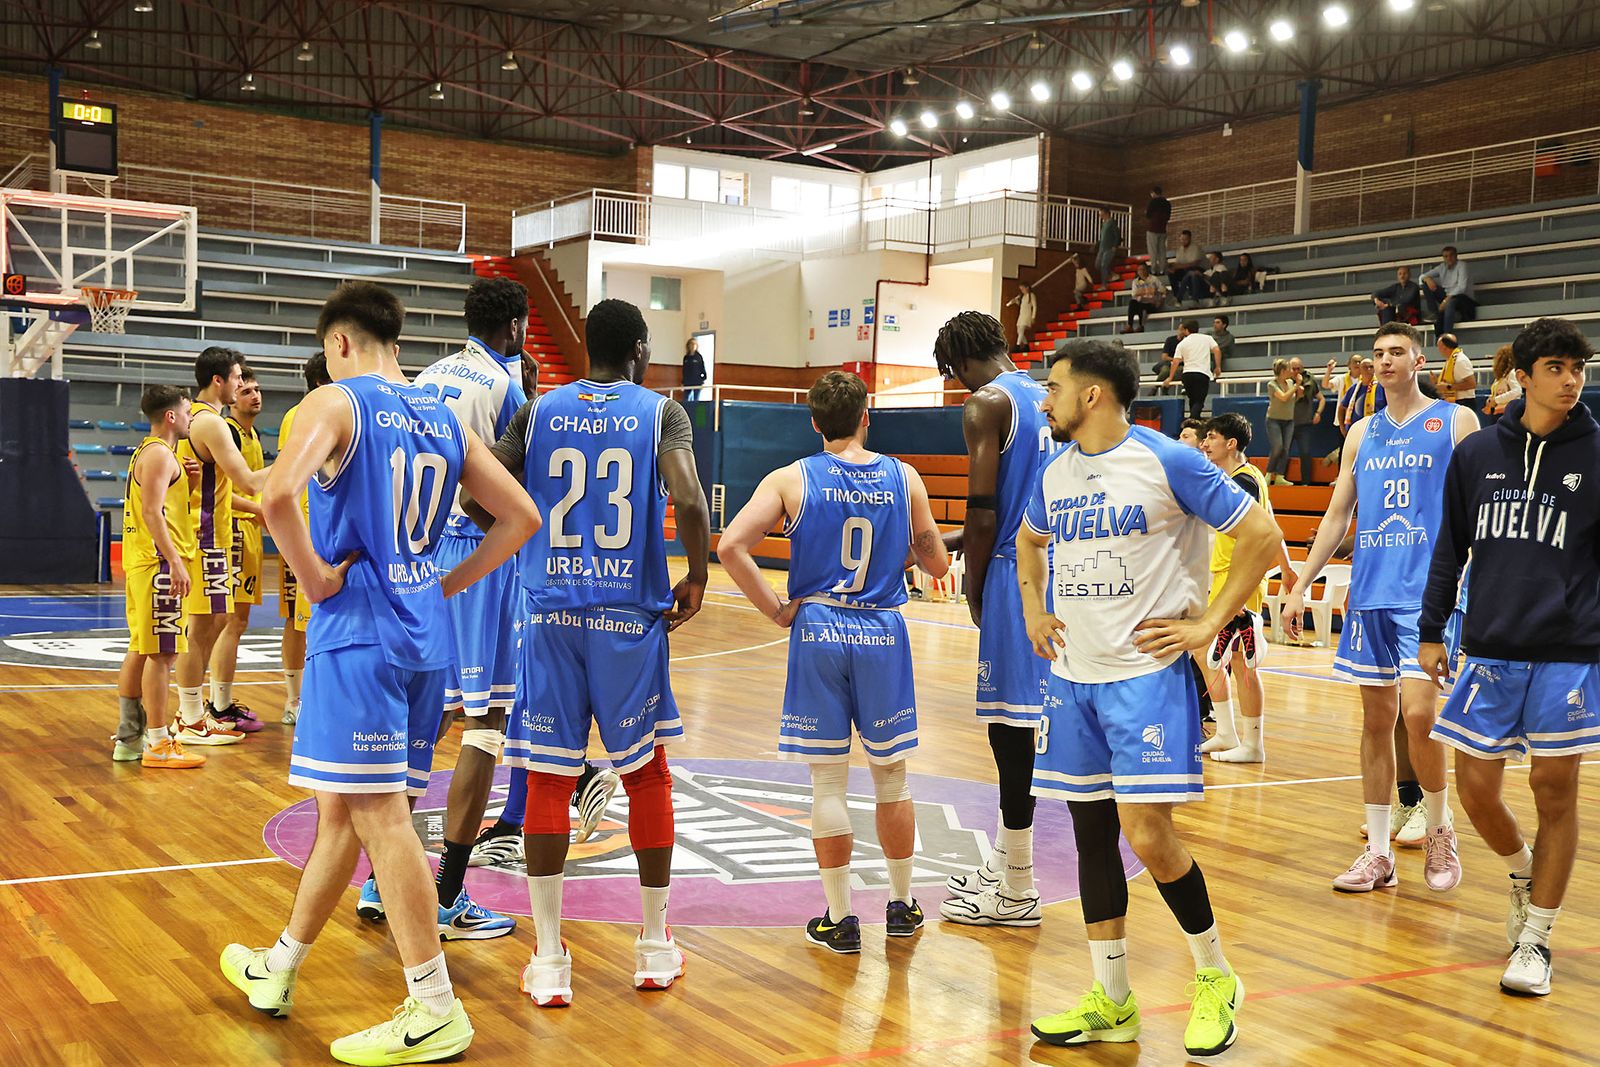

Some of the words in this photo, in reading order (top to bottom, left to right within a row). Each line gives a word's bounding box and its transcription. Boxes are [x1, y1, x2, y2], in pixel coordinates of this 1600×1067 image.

[74, 103, 102, 123] 0:0
[549, 415, 608, 435] CHABI
[612, 415, 639, 432] YO
[390, 446, 448, 555] 10
[548, 447, 633, 550] 23
[821, 487, 895, 505] TIMONER
[1049, 494, 1089, 513] CIUDAD
[1090, 491, 1106, 506] DE
[1383, 478, 1410, 509] 28
[1492, 488, 1535, 501] CIUDAD
[1541, 492, 1556, 507] DE
[1049, 504, 1149, 544] HUELVA
[1475, 501, 1568, 550] HUELVA
[1359, 531, 1429, 549] EMERITA
[832, 516, 874, 594] 9
[582, 578, 633, 590] COOPERATIVAS
[151, 572, 183, 636] UEM
[546, 610, 644, 635] Abundancia
[801, 628, 815, 642] La
[818, 628, 895, 646] Abundancia
[1462, 682, 1481, 715] 1
[531, 712, 555, 724] eleva
[352, 742, 369, 751] tus
[353, 731, 389, 742] Huelva
